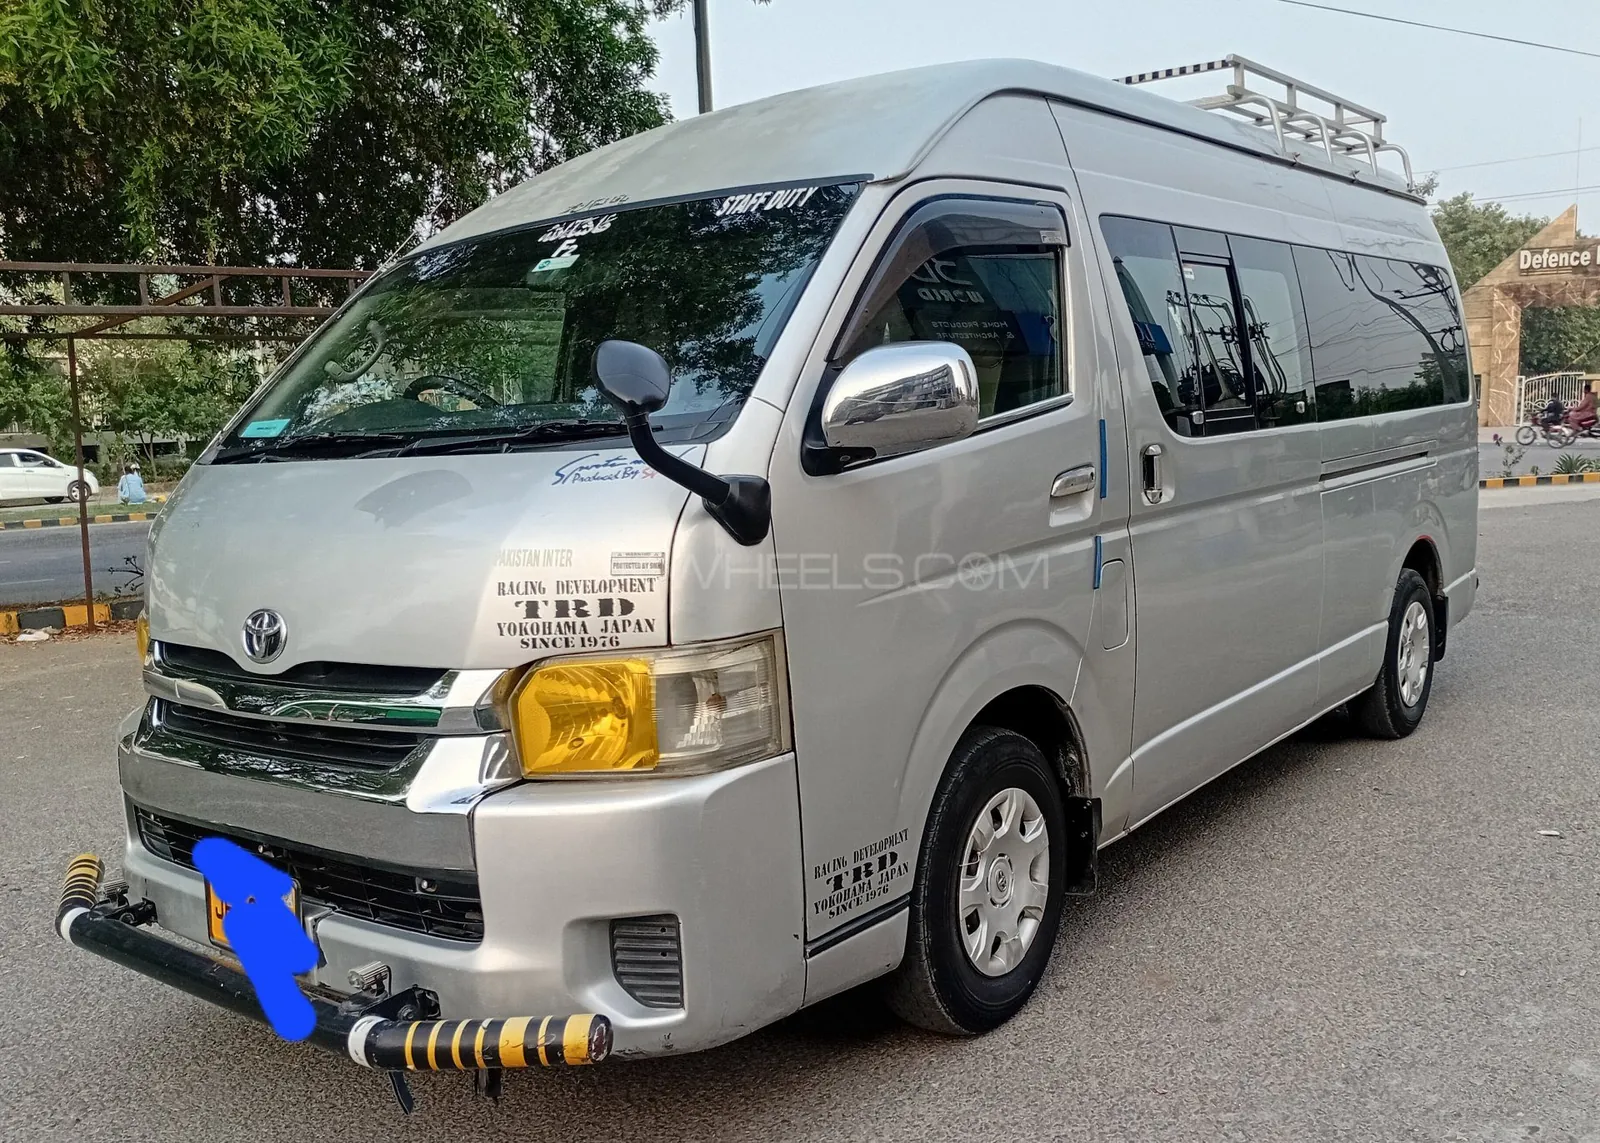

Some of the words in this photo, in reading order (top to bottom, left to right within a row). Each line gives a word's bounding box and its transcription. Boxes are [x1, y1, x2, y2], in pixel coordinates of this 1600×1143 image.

[715, 192, 774, 217] STAFF
[763, 186, 819, 211] DUTY
[1519, 249, 1591, 270] Defence
[621, 466, 641, 480] By
[541, 548, 574, 568] INTER
[497, 581, 547, 597] RACING
[556, 577, 657, 596] DEVELOPMENT
[513, 597, 636, 620] TRD
[496, 620, 590, 637] YOKOHAMA
[600, 618, 657, 634] JAPAN
[520, 636, 576, 650] SINCE
[579, 635, 621, 648] 1976
[814, 856, 848, 880] RACING
[853, 828, 909, 864] DEVELOPMENT
[825, 851, 899, 894] TRD
[813, 879, 872, 915] YOKOHAMA
[878, 861, 910, 886] JAPAN
[828, 895, 863, 920] SINCE
[864, 884, 890, 903] 1976
